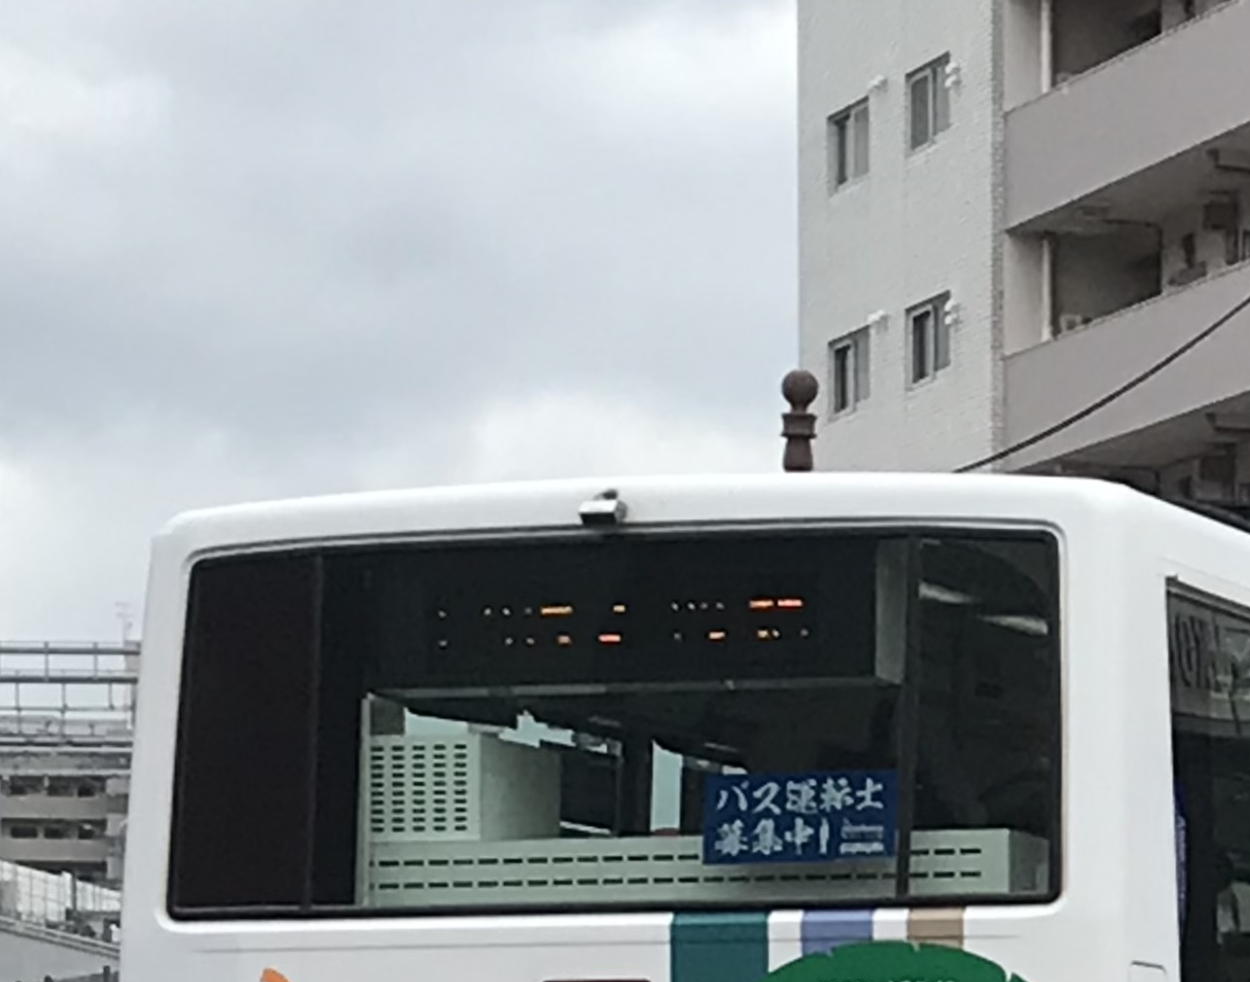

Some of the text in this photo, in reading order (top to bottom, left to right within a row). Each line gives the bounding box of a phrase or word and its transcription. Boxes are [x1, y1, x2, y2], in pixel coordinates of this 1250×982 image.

[715, 776, 885, 816] バス運転士
